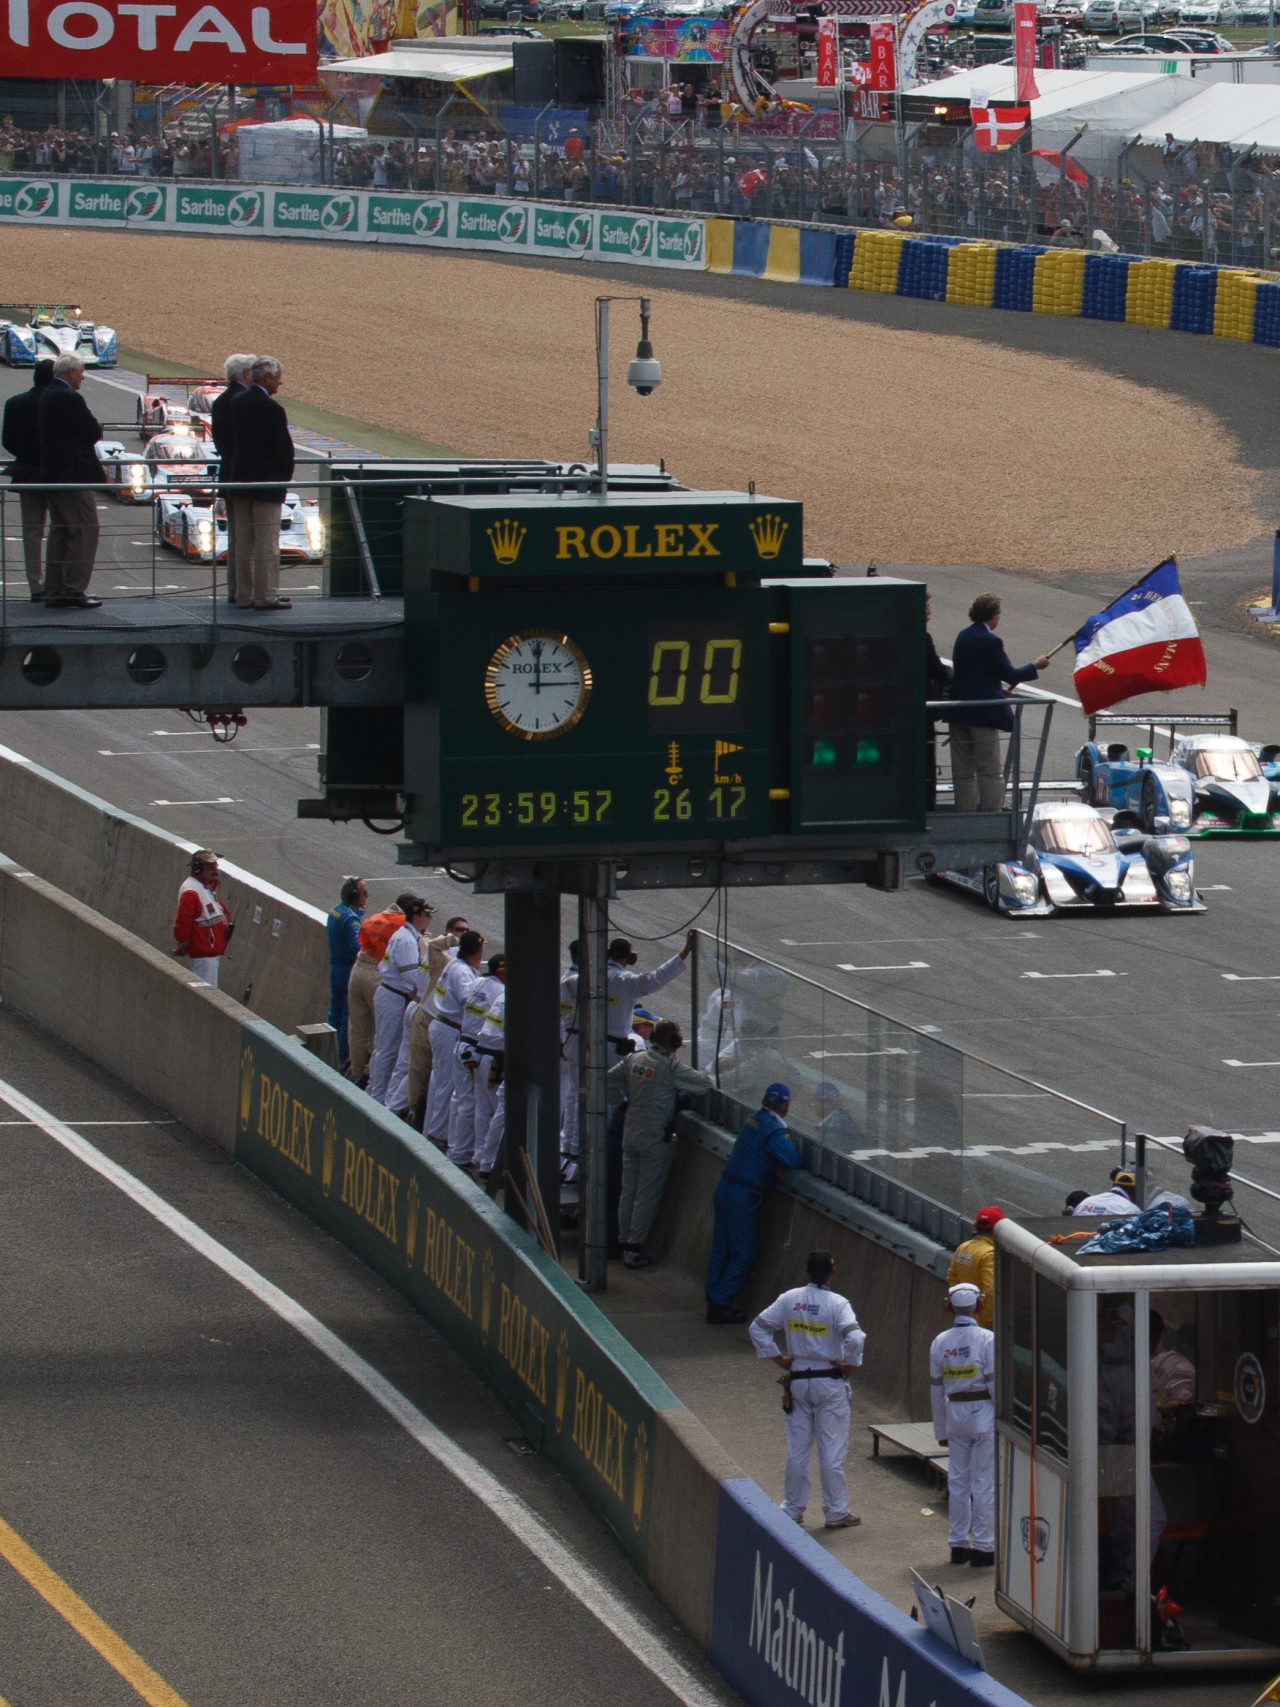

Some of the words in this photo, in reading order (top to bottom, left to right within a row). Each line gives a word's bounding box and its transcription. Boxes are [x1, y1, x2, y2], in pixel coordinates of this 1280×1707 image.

[823, 42, 833, 84] BAR
[877, 45, 889, 88] BAR
[860, 90, 880, 118] BAR
[74, 192, 122, 211] Sarthe
[180, 197, 225, 217] Sarthe
[278, 202, 320, 222] Sarthe
[373, 206, 411, 226] Sarthe
[460, 211, 497, 232] Sarthe
[537, 218, 566, 240] Sarthe
[602, 224, 629, 246] Sarthe
[659, 231, 683, 251] Sarthe
[555, 524, 720, 560] ROLEX
[512, 663, 562, 673] ROLEX
[648, 639, 742, 706] 00
[714, 773, 742, 784] km/h
[461, 790, 612, 826] 23:59:57
[654, 789, 692, 820] 26
[708, 787, 747, 818] 17
[257, 1074, 315, 1176] ROLEX
[341, 1137, 400, 1245] ROLEX
[423, 1206, 475, 1320] ROLEX
[793, 1303, 807, 1311] 24
[499, 1282, 550, 1405] ROLEX
[944, 1349, 957, 1358] 24
[572, 1368, 628, 1500] ROLEX
[749, 1550, 845, 1707] Matmut
